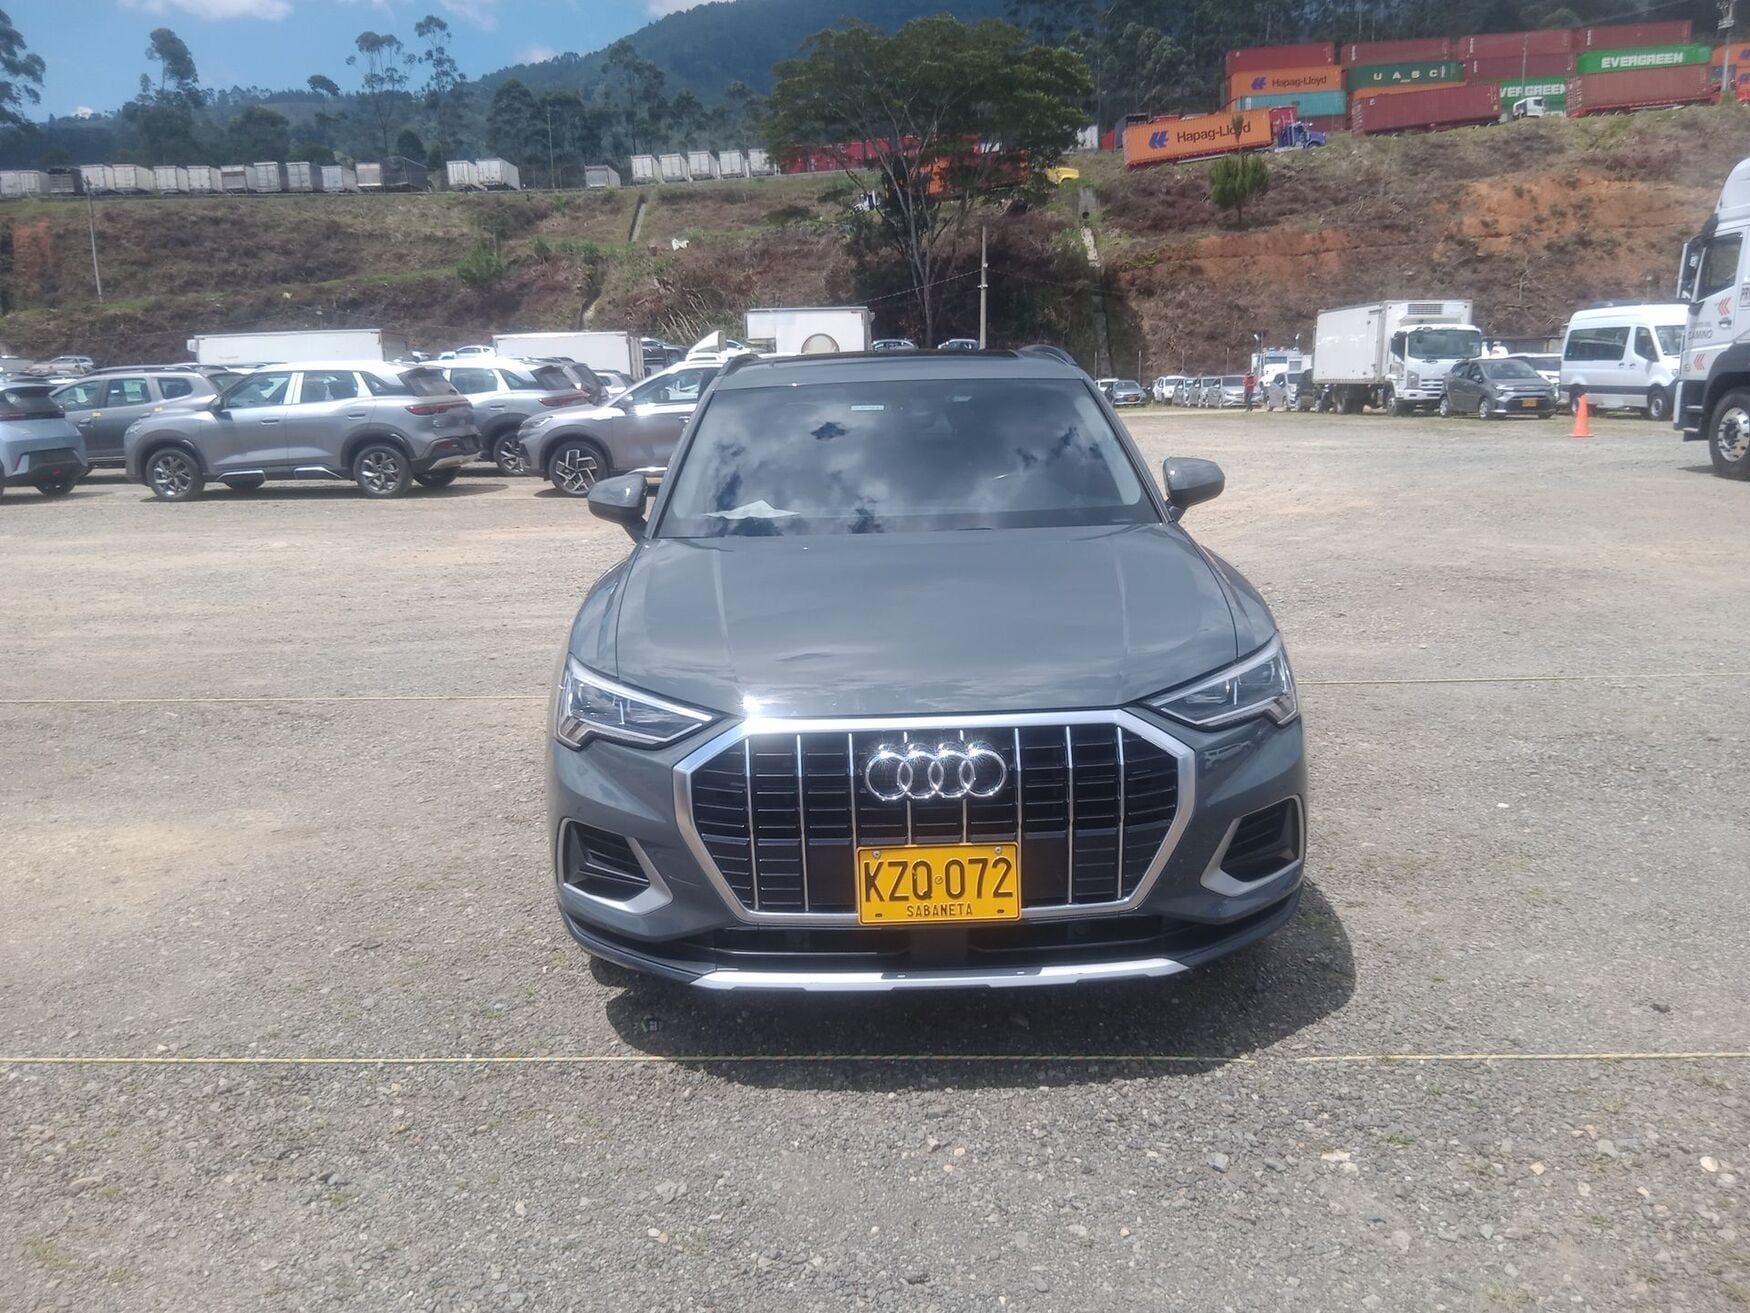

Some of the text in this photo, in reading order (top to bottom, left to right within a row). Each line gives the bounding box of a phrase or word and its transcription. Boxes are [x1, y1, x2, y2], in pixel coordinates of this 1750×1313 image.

[1601, 52, 1684, 69] EVERGREEN
[1272, 76, 1328, 88] Hapag-Lloyd
[863, 856, 1013, 903] KZQ 072
[906, 903, 973, 918] SABANETA
